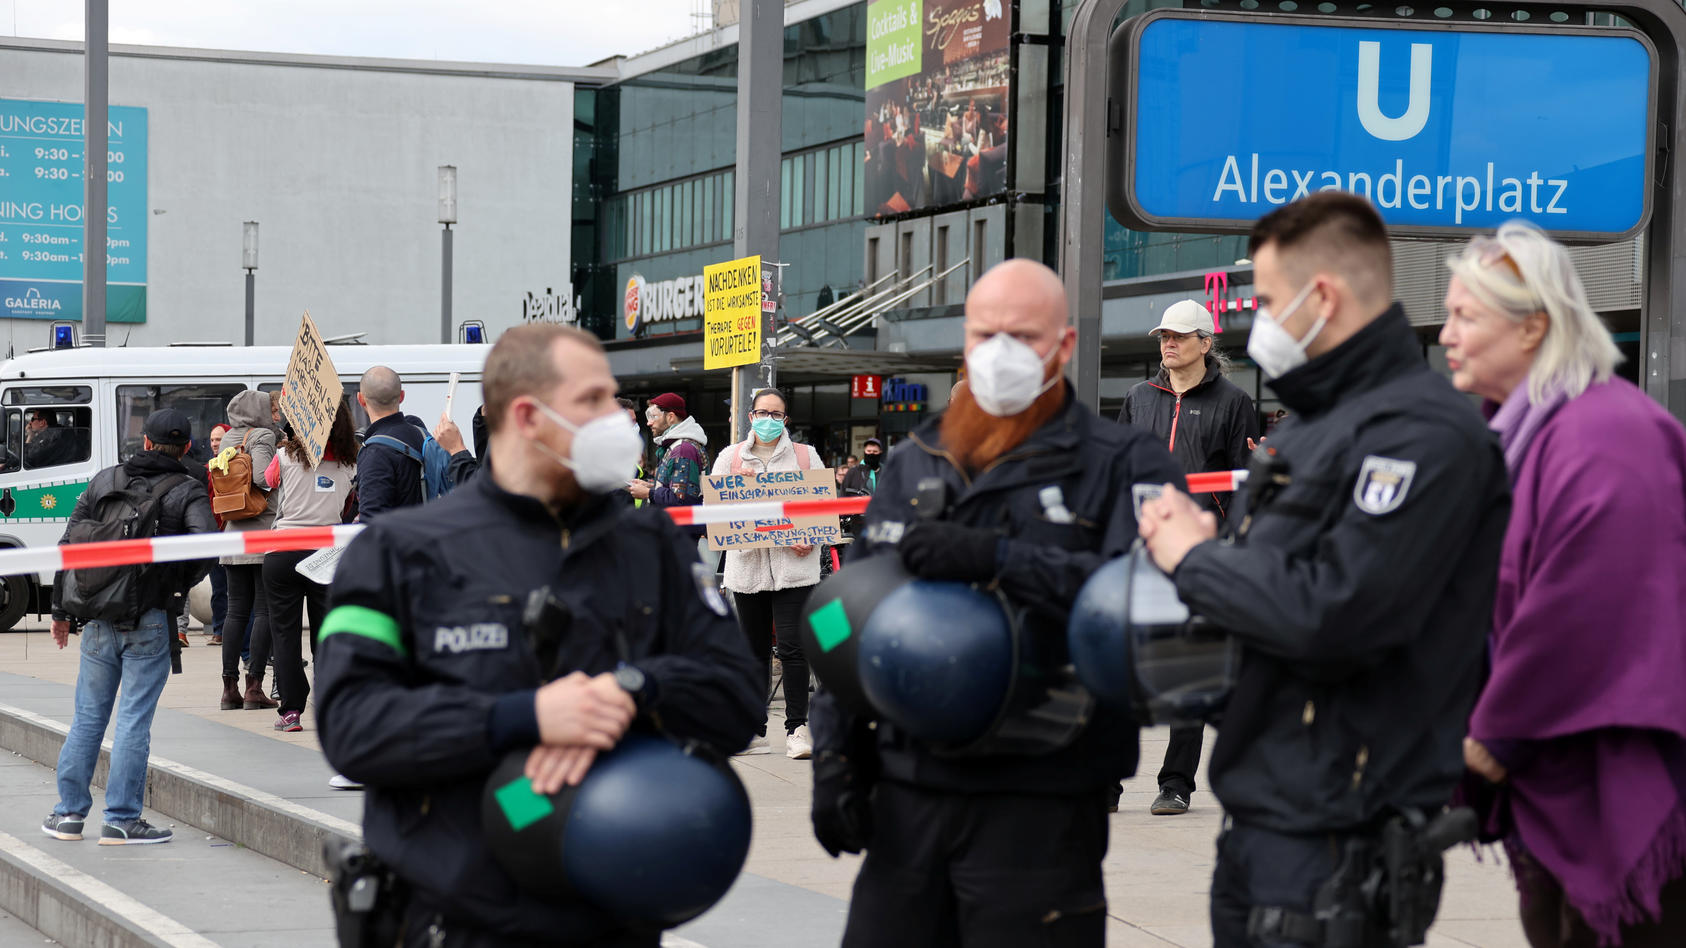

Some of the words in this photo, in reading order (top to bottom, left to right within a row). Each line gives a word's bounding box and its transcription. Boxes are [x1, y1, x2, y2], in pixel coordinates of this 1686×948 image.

[872, 5, 907, 40] Cocktails
[1357, 41, 1432, 141] U
[35, 148, 68, 160] 9:30
[35, 167, 68, 179] 9:30
[22, 233, 69, 244] 9:30am
[22, 251, 69, 262] 9:30am
[709, 265, 757, 293] NACHDENKEN
[5, 297, 61, 309] GALERIA
[642, 275, 705, 323] BURGER
[707, 298, 716, 312] IST
[716, 297, 725, 310] DIE
[727, 290, 759, 309] WIRKSAMSTE
[707, 321, 732, 334] THERAPIE
[737, 316, 756, 331] GEGEN
[300, 322, 323, 372] BITTE
[709, 475, 745, 490] WER
[756, 471, 804, 484] GEGEN
[729, 520, 746, 529] IST
[755, 518, 791, 528] KEIN
[434, 623, 508, 653] POLIZEI
